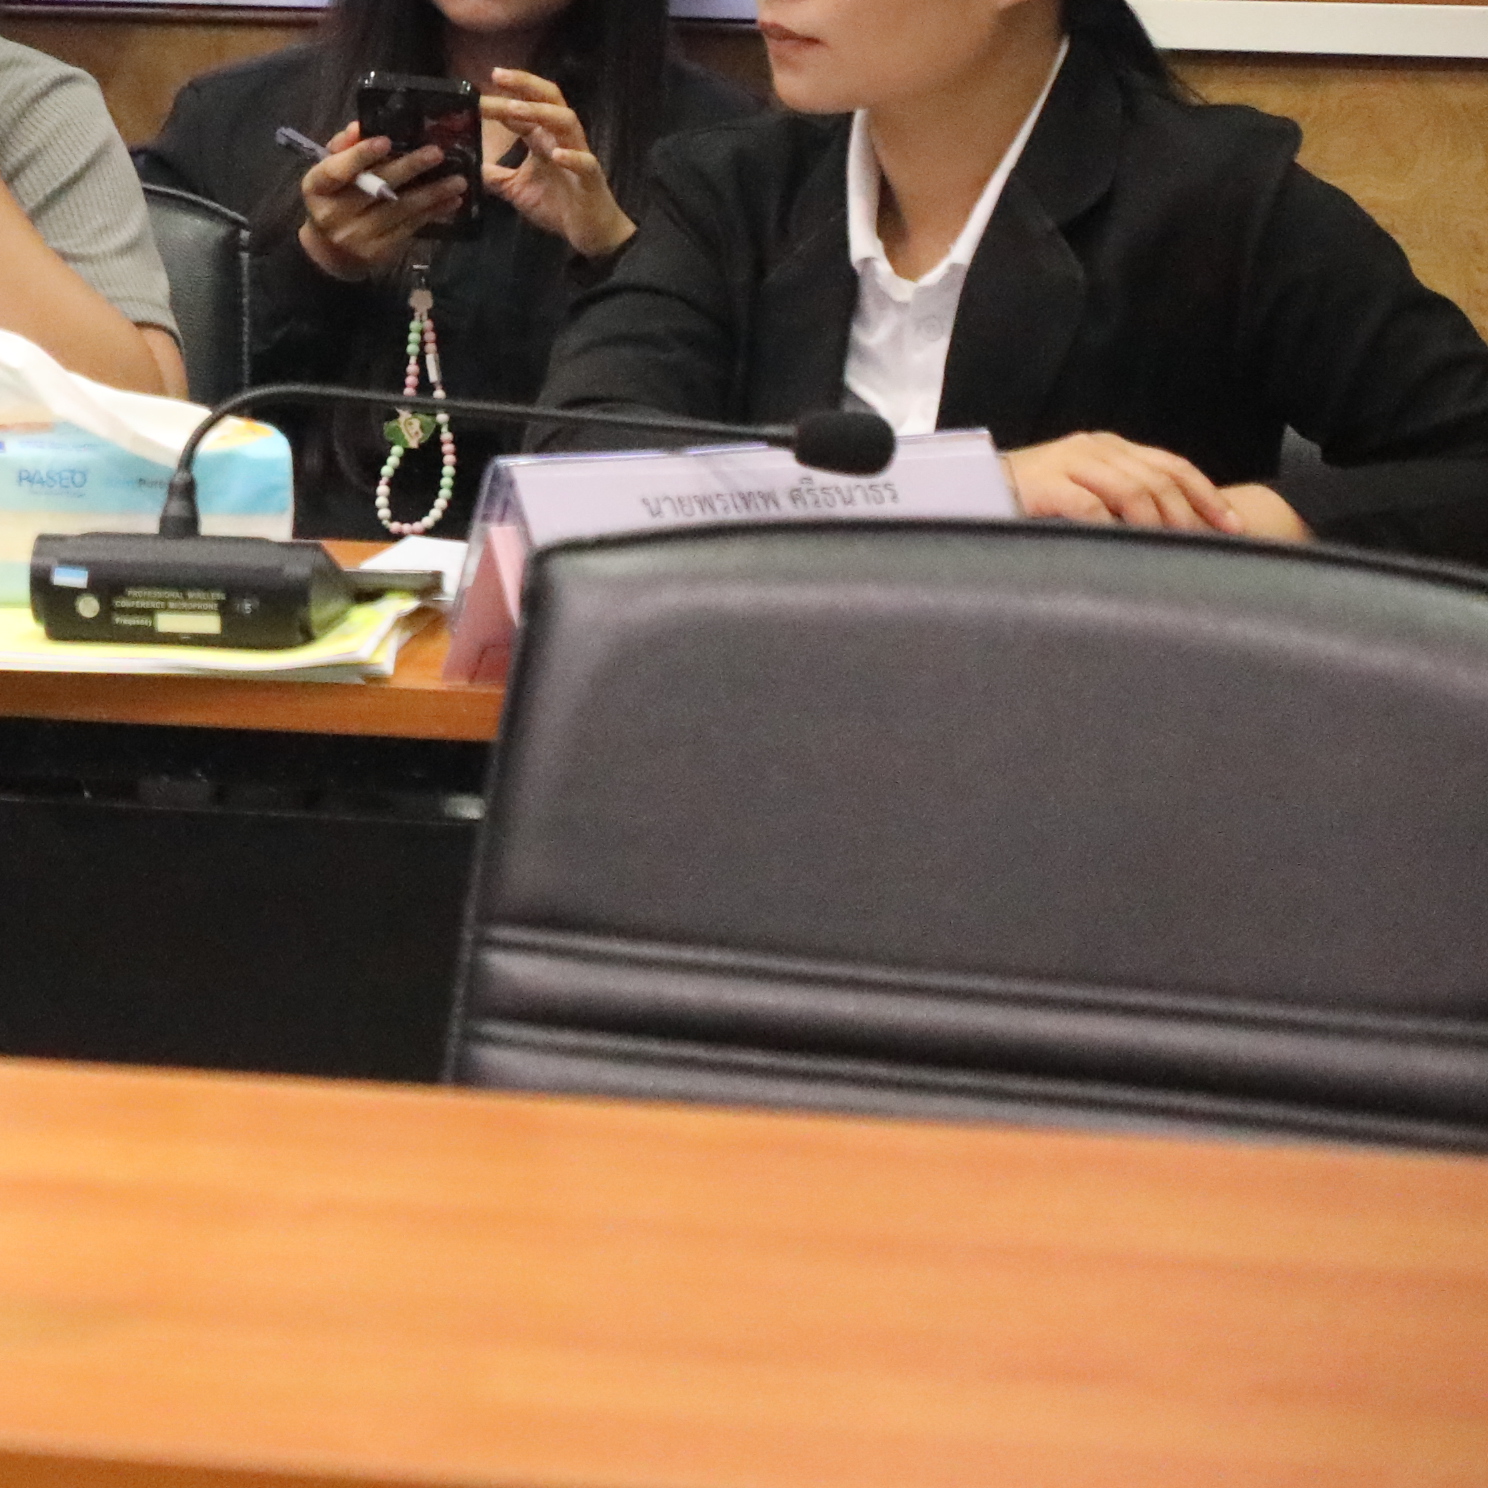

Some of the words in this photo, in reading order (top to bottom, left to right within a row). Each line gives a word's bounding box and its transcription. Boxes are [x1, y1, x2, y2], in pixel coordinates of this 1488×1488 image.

[17, 468, 88, 489] PASEO
[641, 489, 781, 519] นายพรเทพ
[788, 476, 900, 510] ศรีธนาธร
[127, 589, 184, 600] PROFESSIONAL
[187, 591, 227, 602] WIRELESS
[114, 599, 166, 610] CONFERENCE
[167, 601, 219, 611] MICROPHONE
